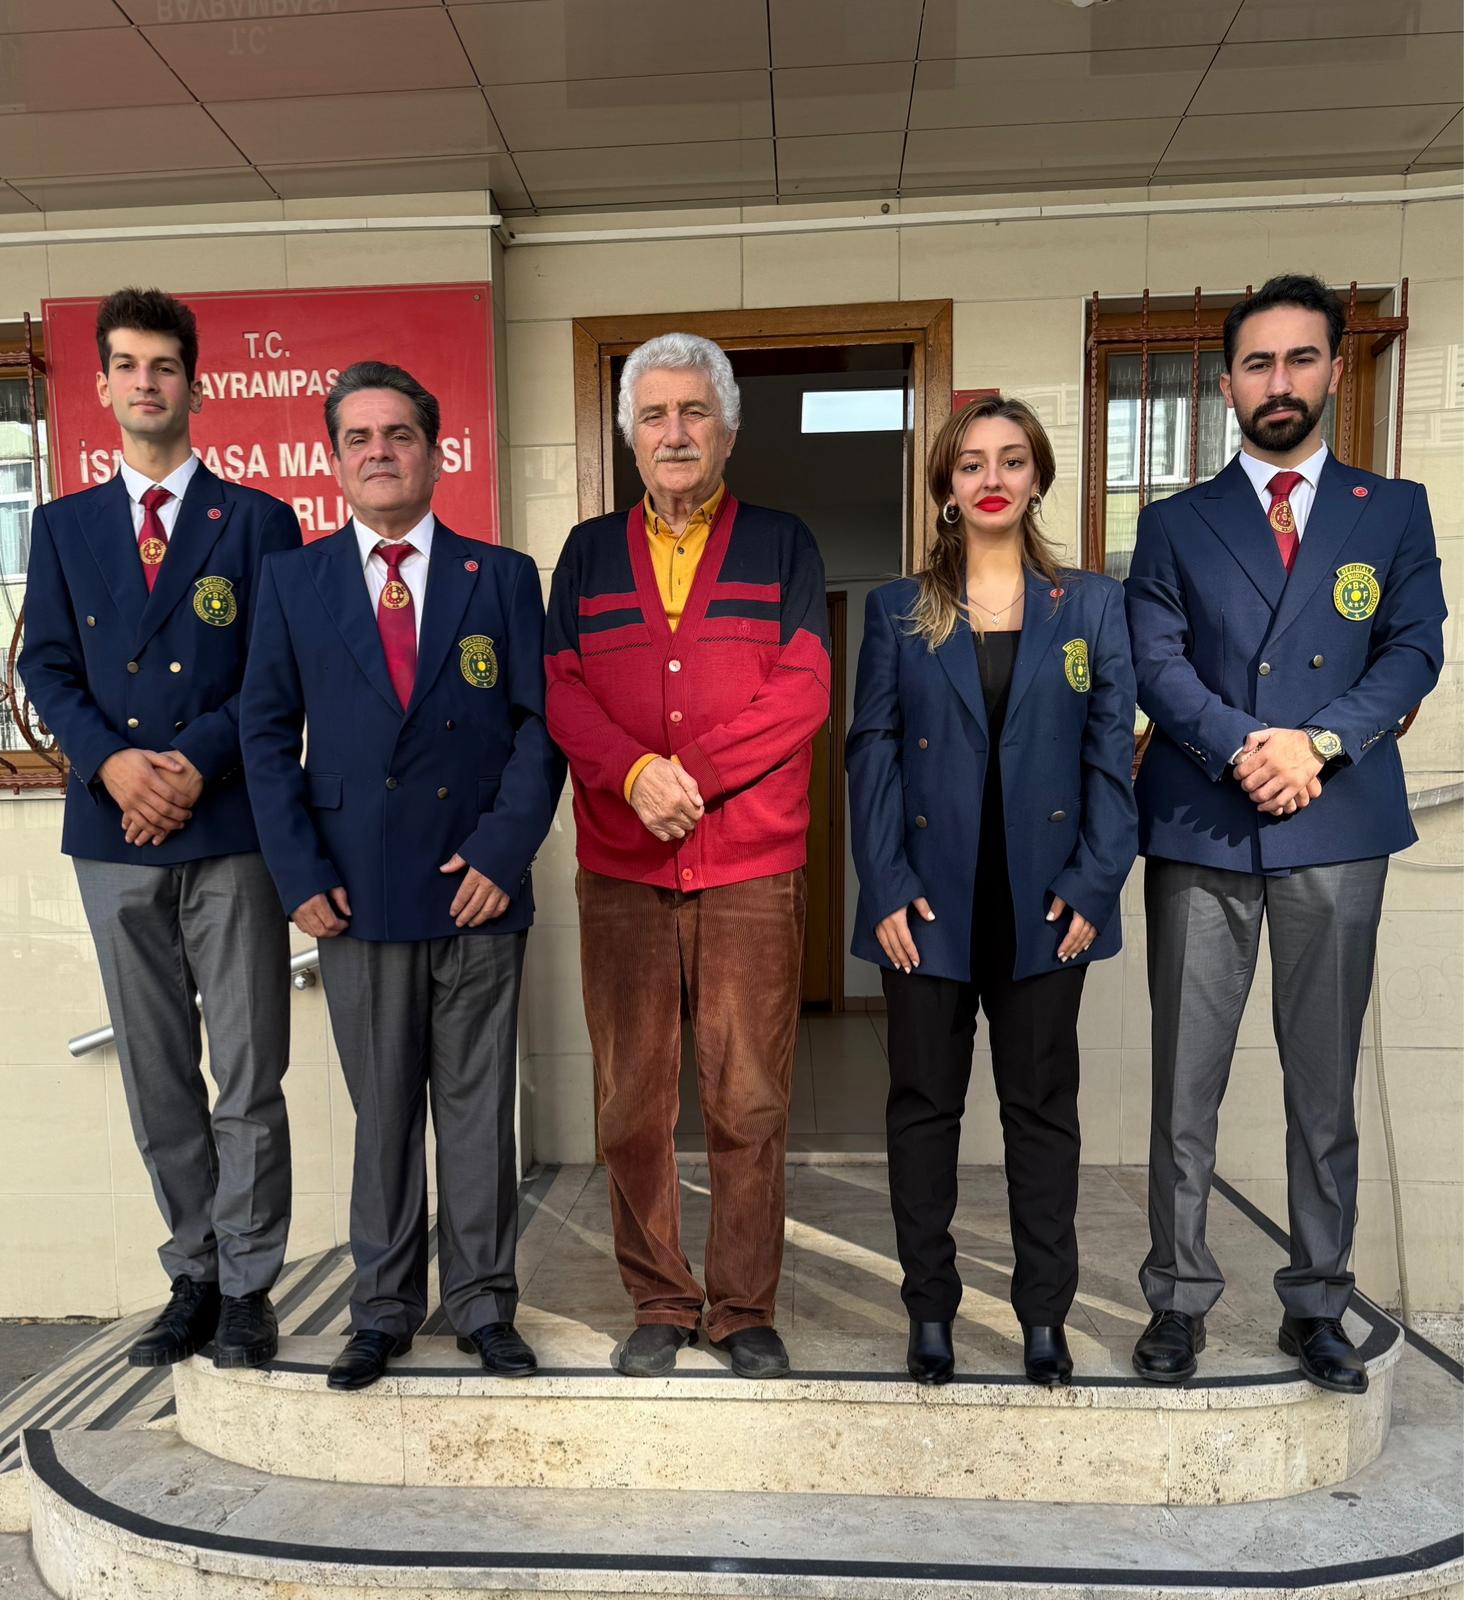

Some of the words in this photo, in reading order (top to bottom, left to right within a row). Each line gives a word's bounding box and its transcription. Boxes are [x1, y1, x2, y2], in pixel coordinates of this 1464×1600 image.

[243, 331, 290, 359] T.C.
[200, 368, 340, 399] AYRAMPAS
[1341, 565, 1370, 575] OFFICIAL
